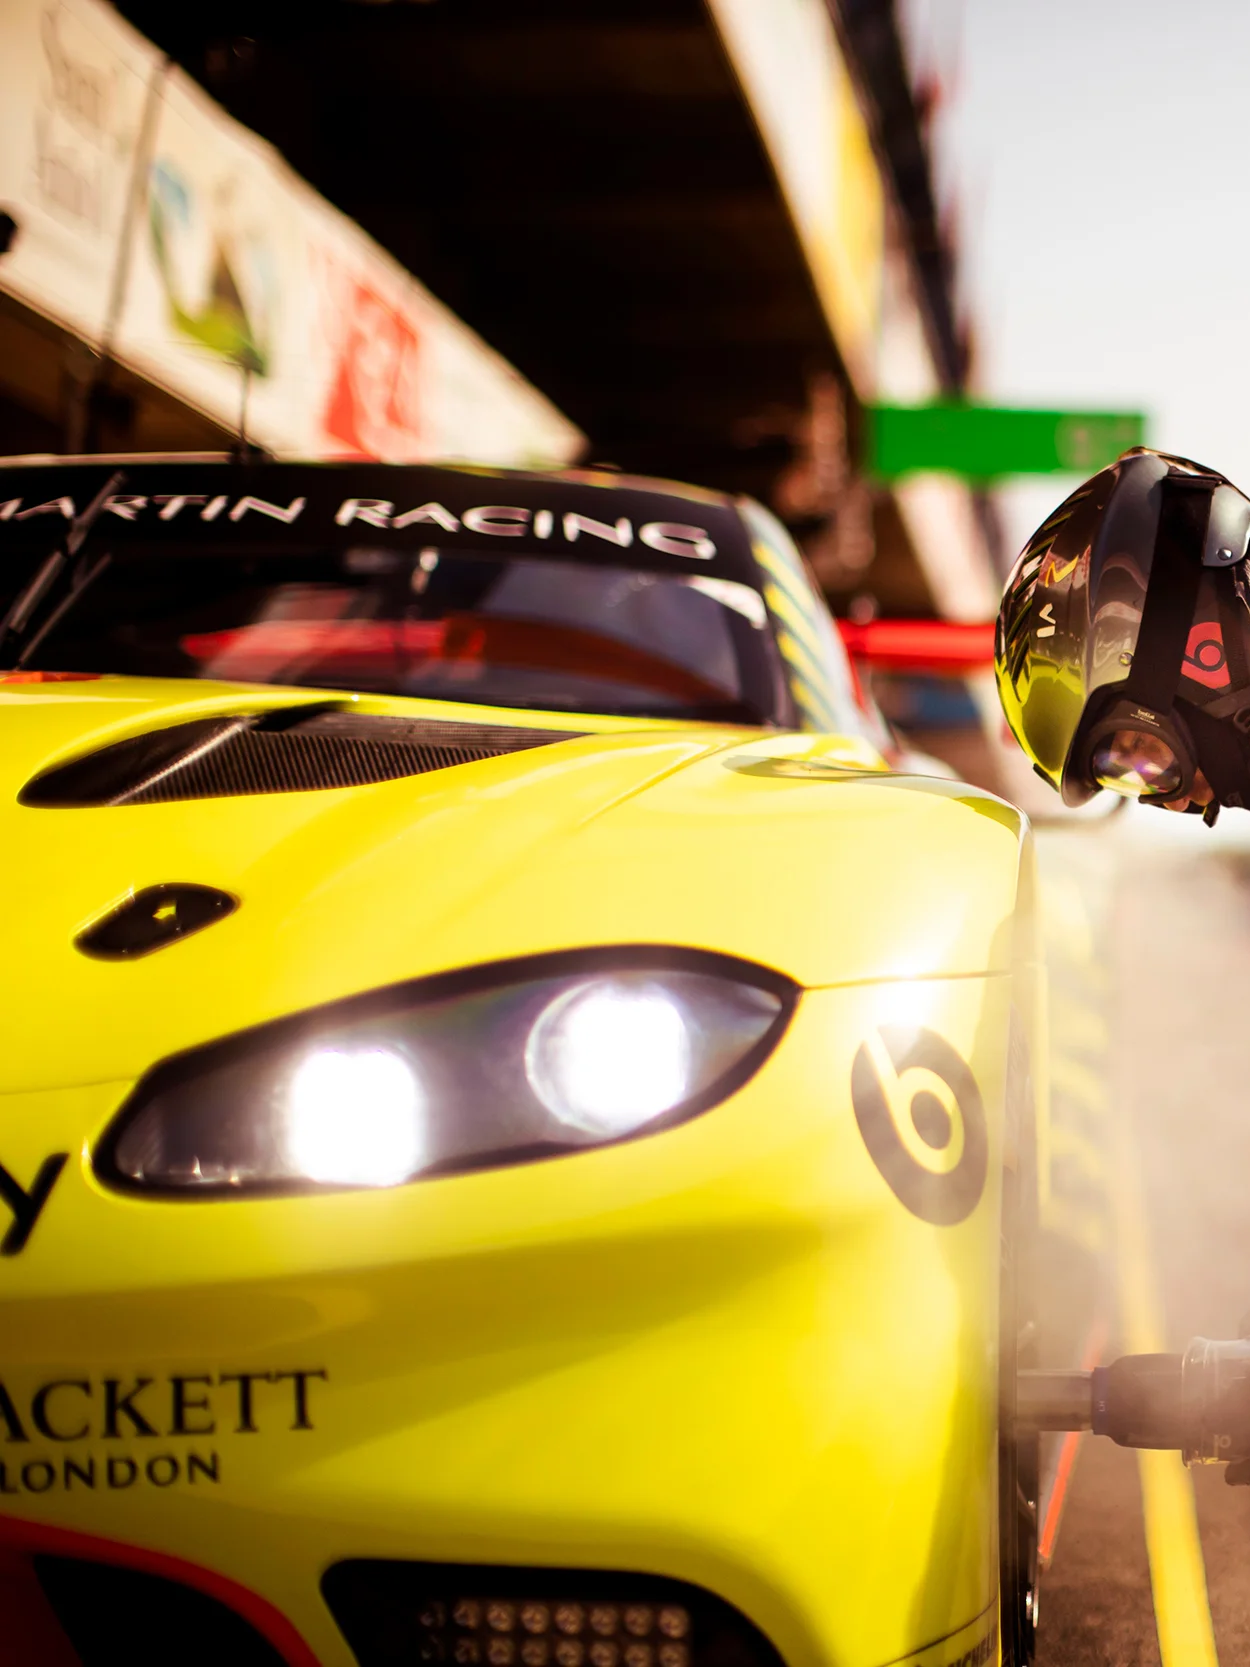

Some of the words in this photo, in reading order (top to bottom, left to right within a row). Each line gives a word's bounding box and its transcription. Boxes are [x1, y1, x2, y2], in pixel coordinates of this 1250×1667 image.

[0, 496, 307, 525] ARTIN
[335, 498, 717, 560] RACING
[0, 1451, 220, 1494] LONDON
